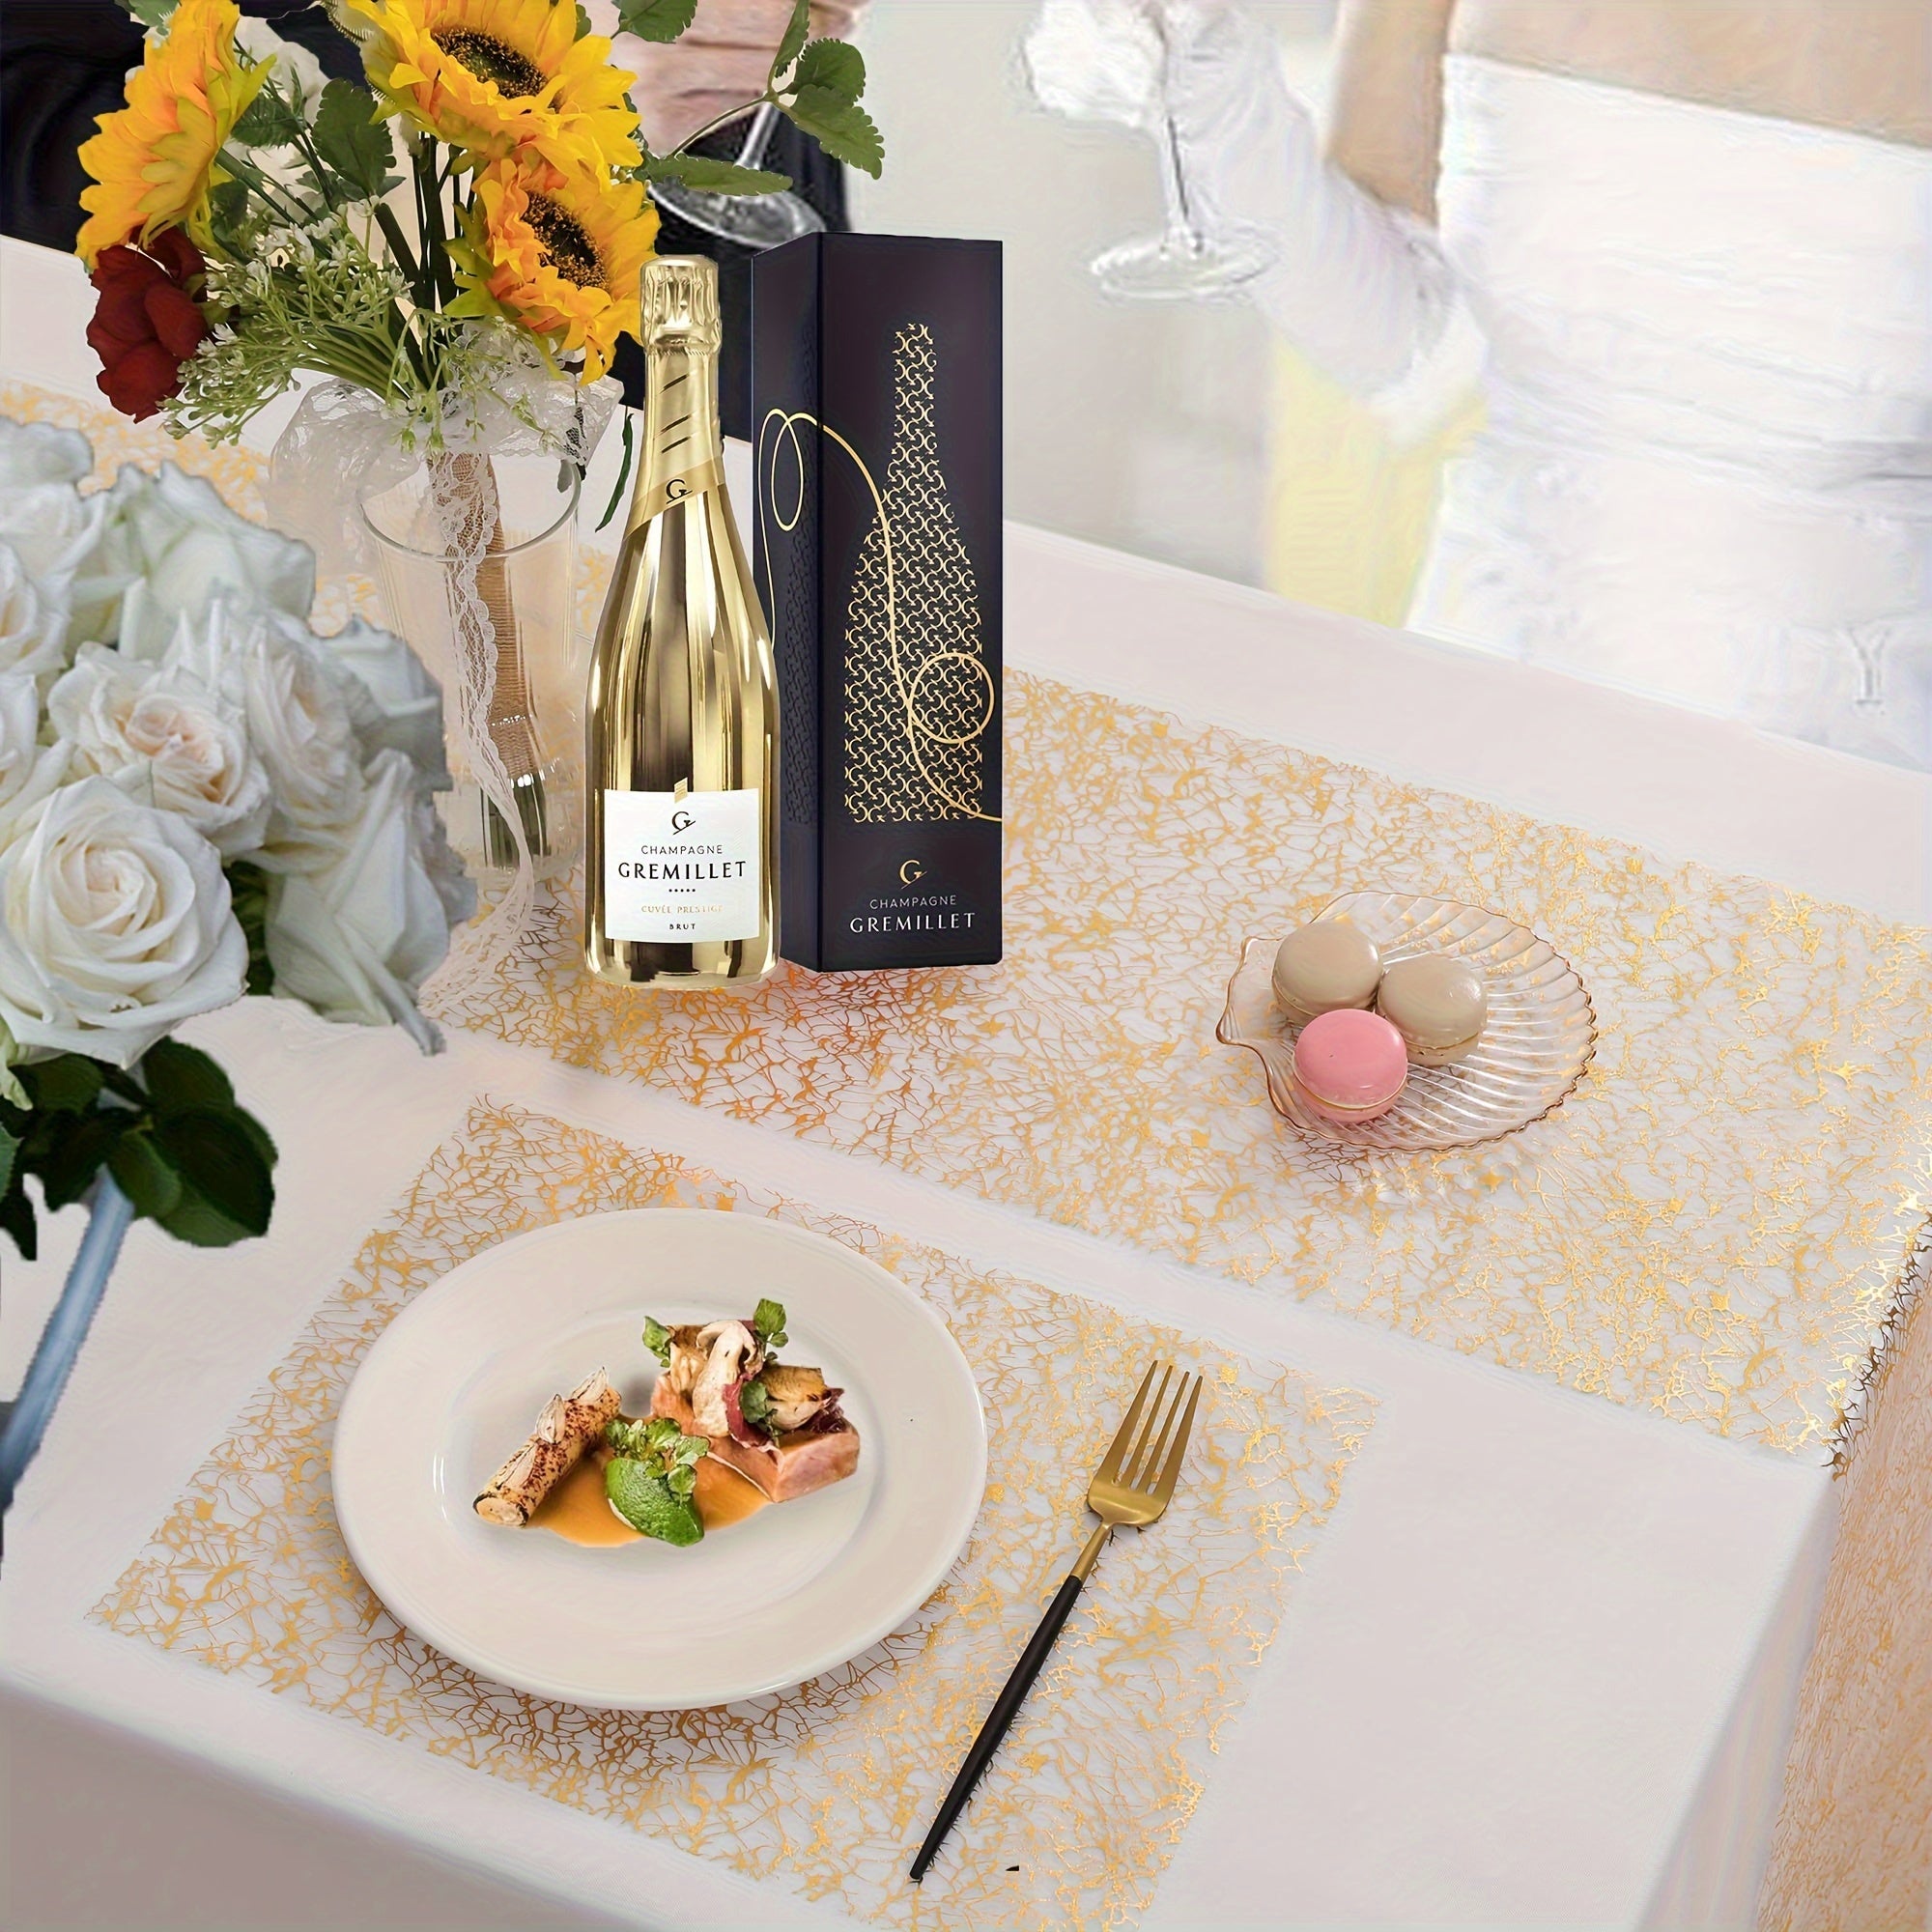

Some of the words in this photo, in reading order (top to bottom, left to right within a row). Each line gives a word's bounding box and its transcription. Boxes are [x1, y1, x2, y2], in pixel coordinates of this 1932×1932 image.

[640, 844, 724, 855] CHAMPAGNE
[617, 861, 747, 880] GREMILLET
[869, 895, 957, 910] CHAMPAGNE
[850, 912, 976, 933] GREMILLET
